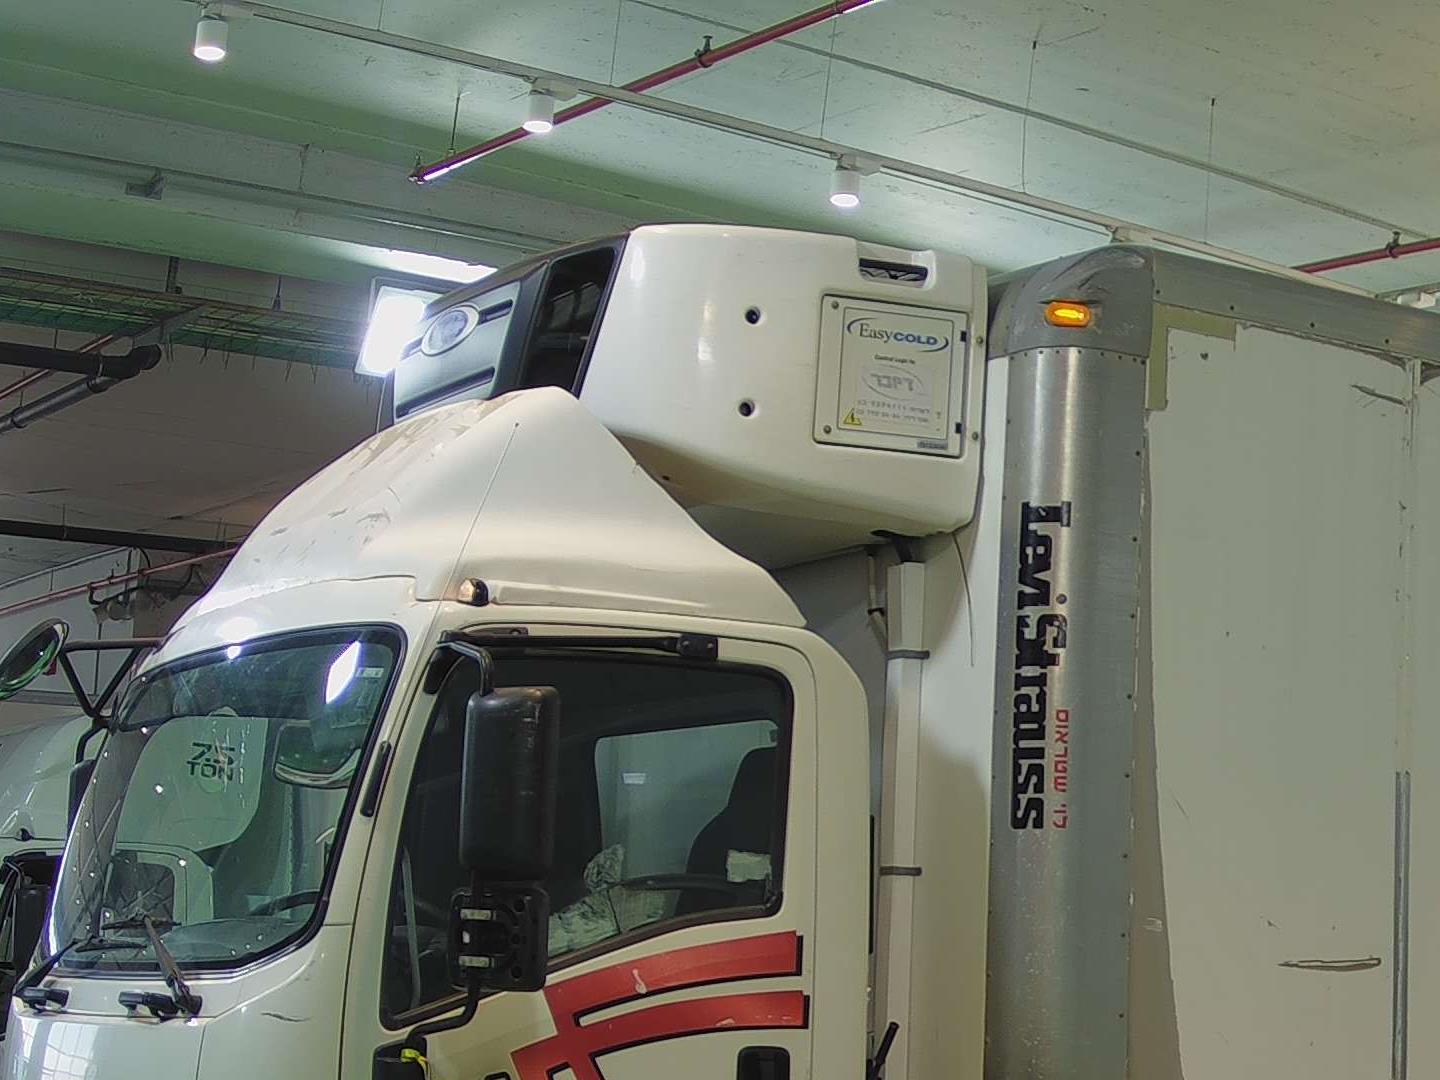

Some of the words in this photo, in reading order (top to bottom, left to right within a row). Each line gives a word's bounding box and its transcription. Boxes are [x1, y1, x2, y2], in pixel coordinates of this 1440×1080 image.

[859, 322, 938, 345] EasyCOLD
[1017, 501, 1071, 610] Levi
[1010, 613, 1068, 830] Strauss
[187, 760, 234, 781] TON
[1054, 709, 1069, 793] שטראוס
[1053, 803, 1069, 829] לוי
